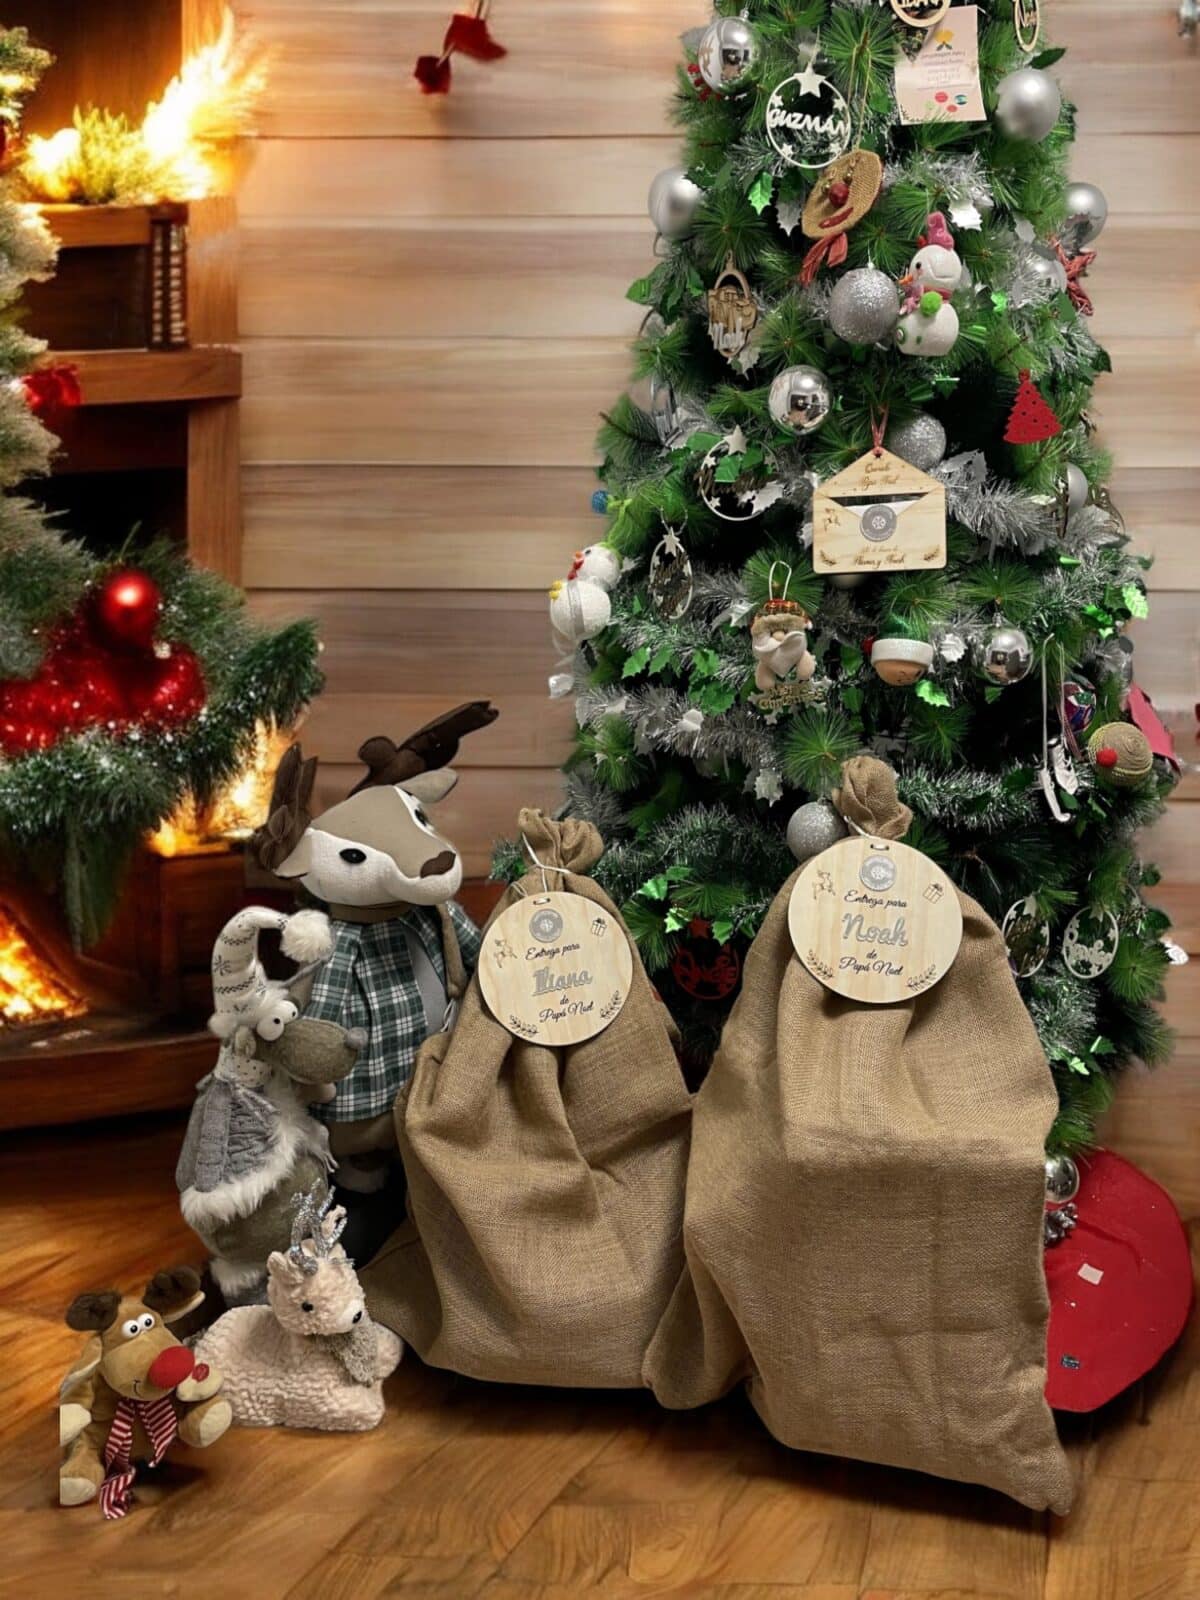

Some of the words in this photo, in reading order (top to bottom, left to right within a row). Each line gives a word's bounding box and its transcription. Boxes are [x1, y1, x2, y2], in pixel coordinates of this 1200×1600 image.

[843, 889, 884, 908] Entrega
[886, 896, 908, 910] para
[842, 912, 909, 947] Noah
[525, 946, 561, 961] Entrega
[561, 943, 580, 956] para
[866, 949, 877, 959] de
[873, 961, 903, 976] Noel
[559, 994, 570, 1006] de
[567, 1001, 595, 1017] Noel
